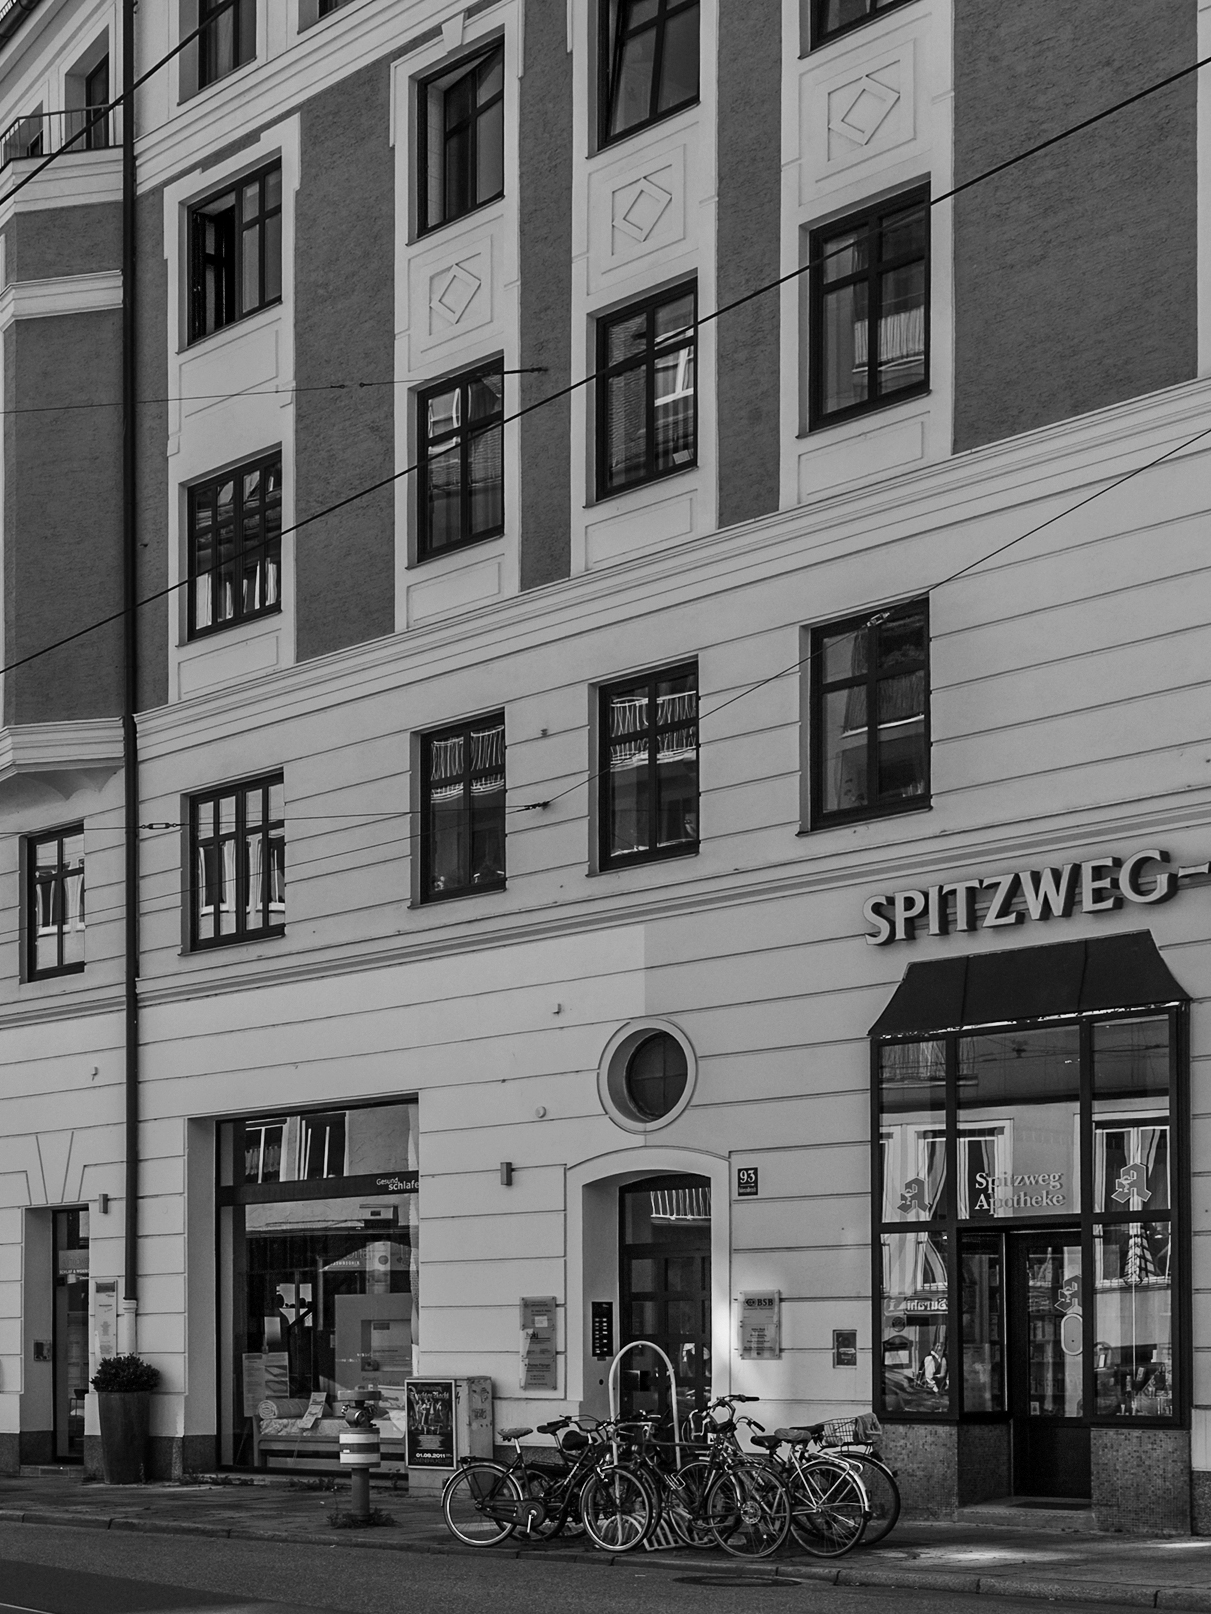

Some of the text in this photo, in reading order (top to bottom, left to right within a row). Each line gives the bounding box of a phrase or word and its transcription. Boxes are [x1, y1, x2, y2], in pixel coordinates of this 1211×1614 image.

[376, 1177, 399, 1186] Gesund
[740, 1170, 755, 1183] 93
[975, 1171, 1063, 1194] Spitzweg
[974, 1189, 1066, 1214] Apotheke
[757, 1298, 773, 1306] BSB
